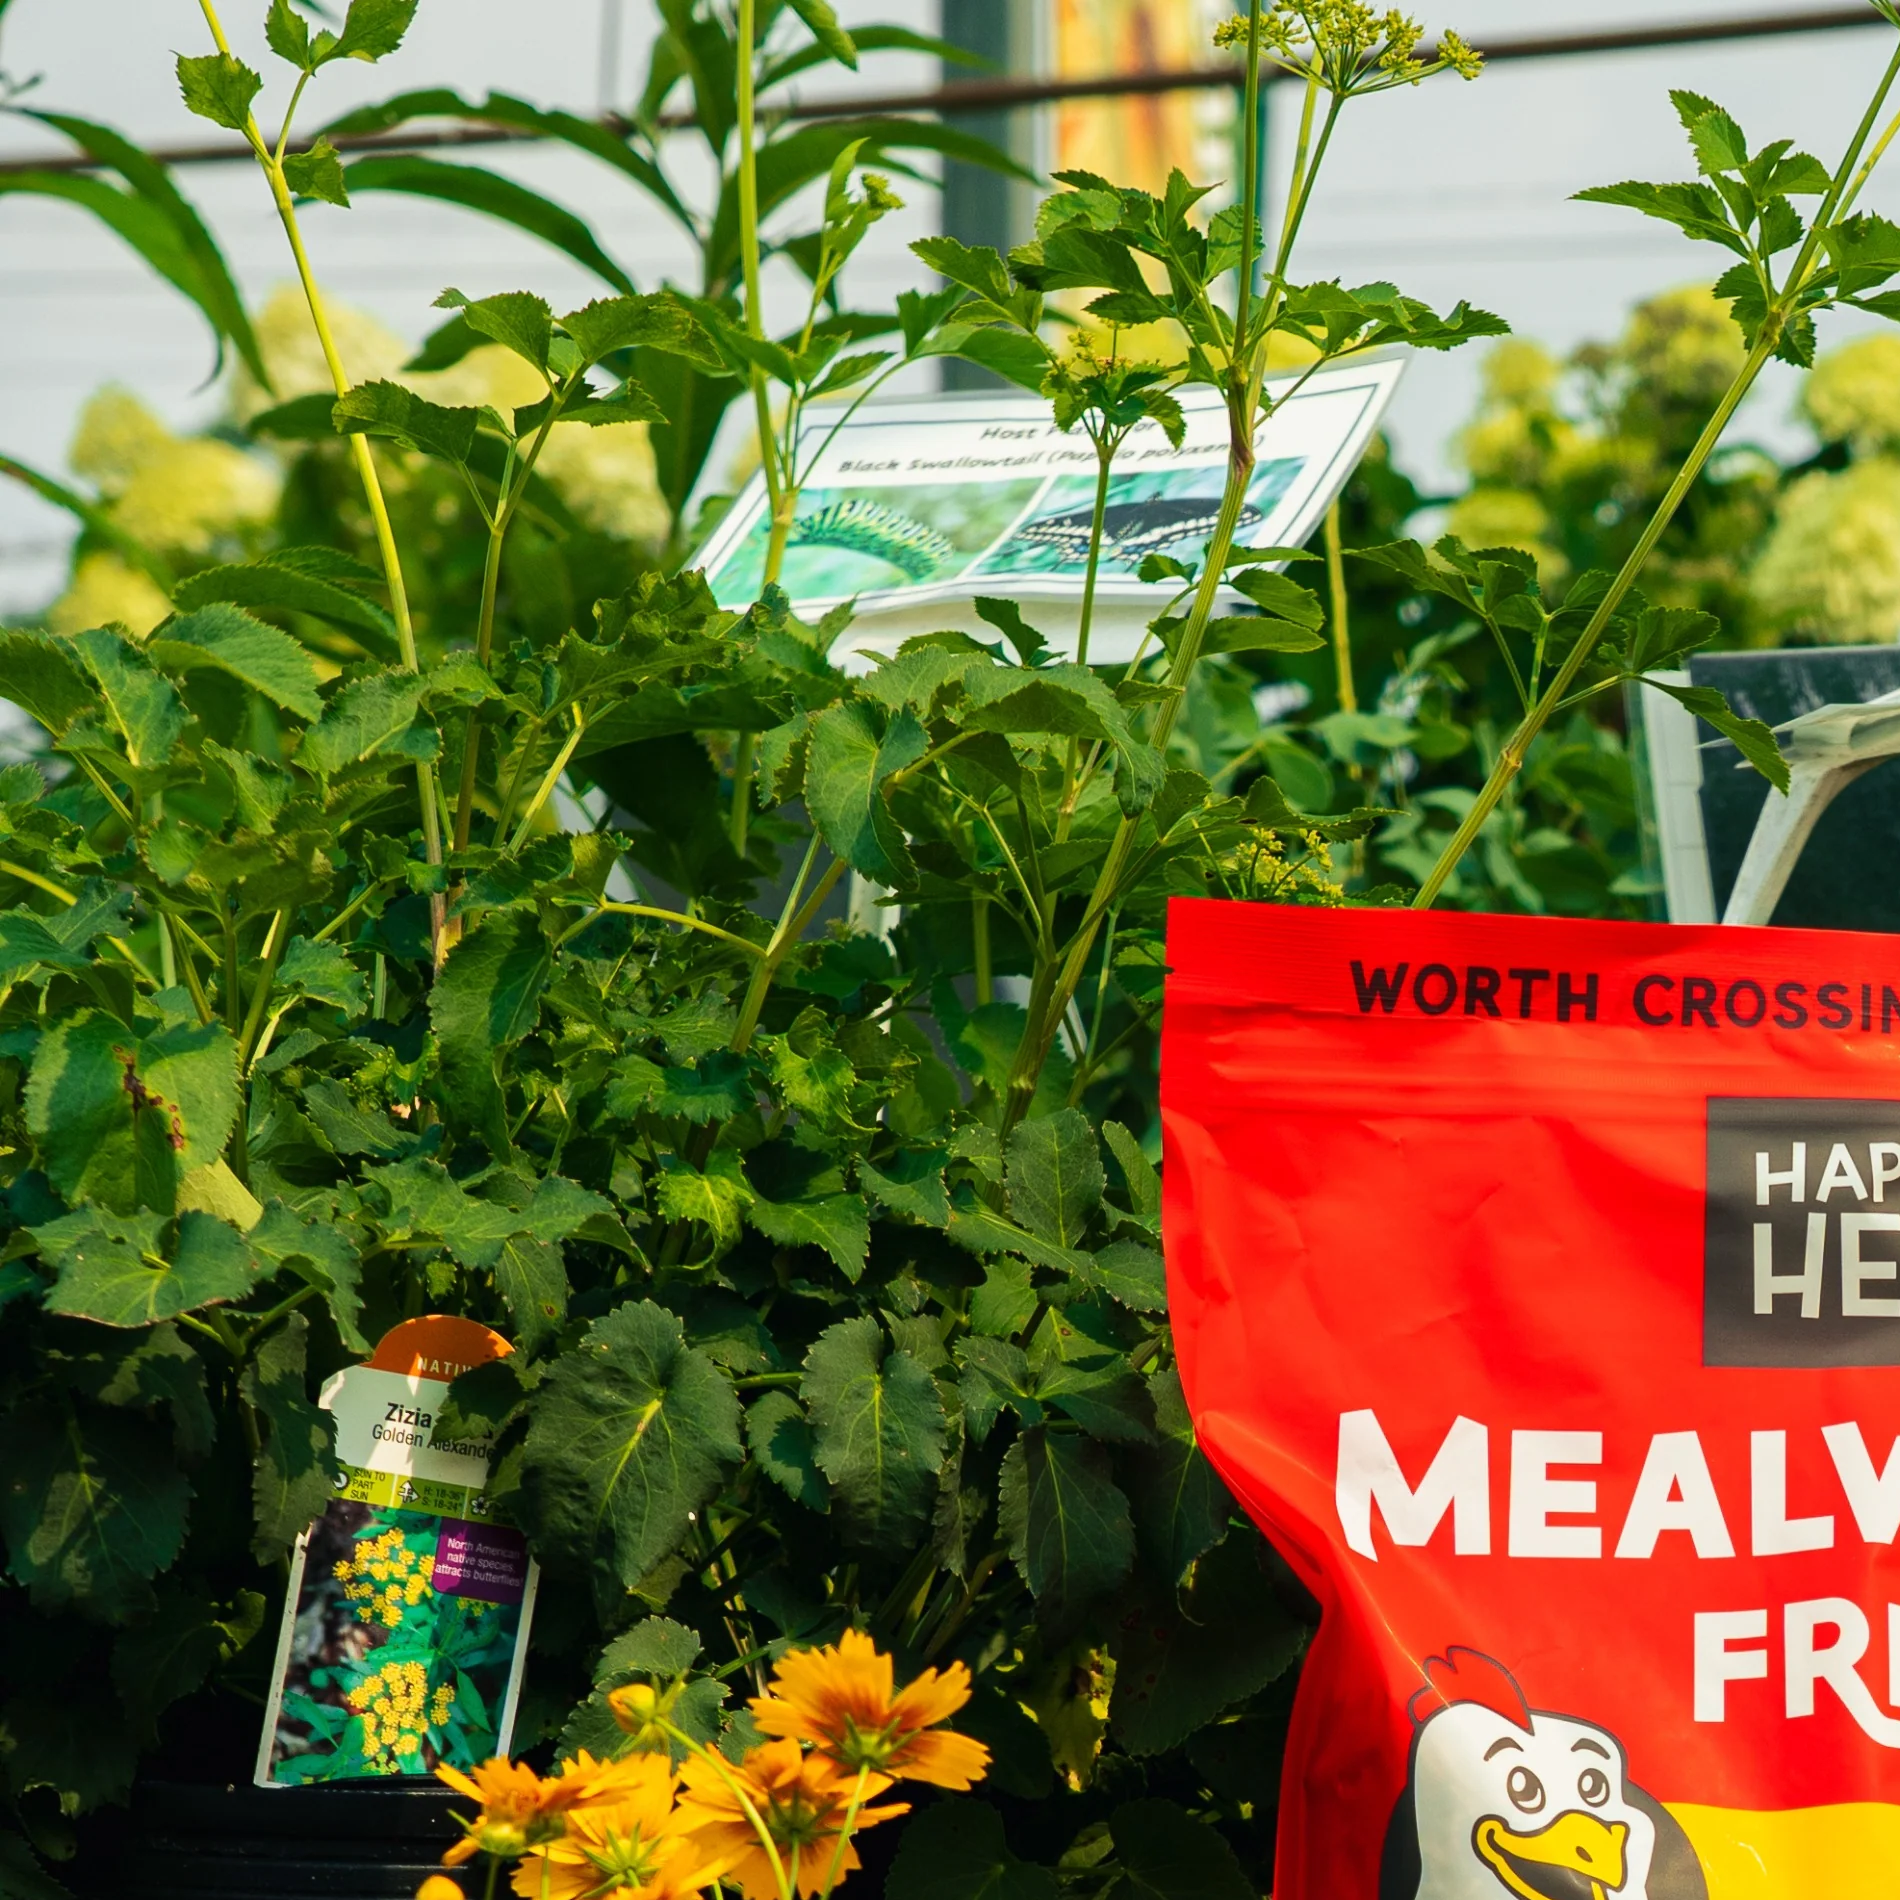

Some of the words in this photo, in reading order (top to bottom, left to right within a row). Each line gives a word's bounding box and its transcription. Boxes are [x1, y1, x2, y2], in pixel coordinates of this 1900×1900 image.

[838, 459, 899, 473] Black
[906, 450, 1044, 472] Swallowtail
[1047, 449, 1135, 464] (Papio
[1349, 960, 1599, 1022] WORTH
[385, 1402, 433, 1428] Zizia
[372, 1424, 424, 1448] Golden
[427, 1438, 496, 1459] Alexande
[351, 1479, 374, 1490] PART
[374, 1470, 386, 1482] TO
[350, 1490, 369, 1501] SUN
[448, 1538, 474, 1551] North
[475, 1543, 520, 1560] American
[447, 1551, 476, 1566] native
[435, 1563, 472, 1578] attracts
